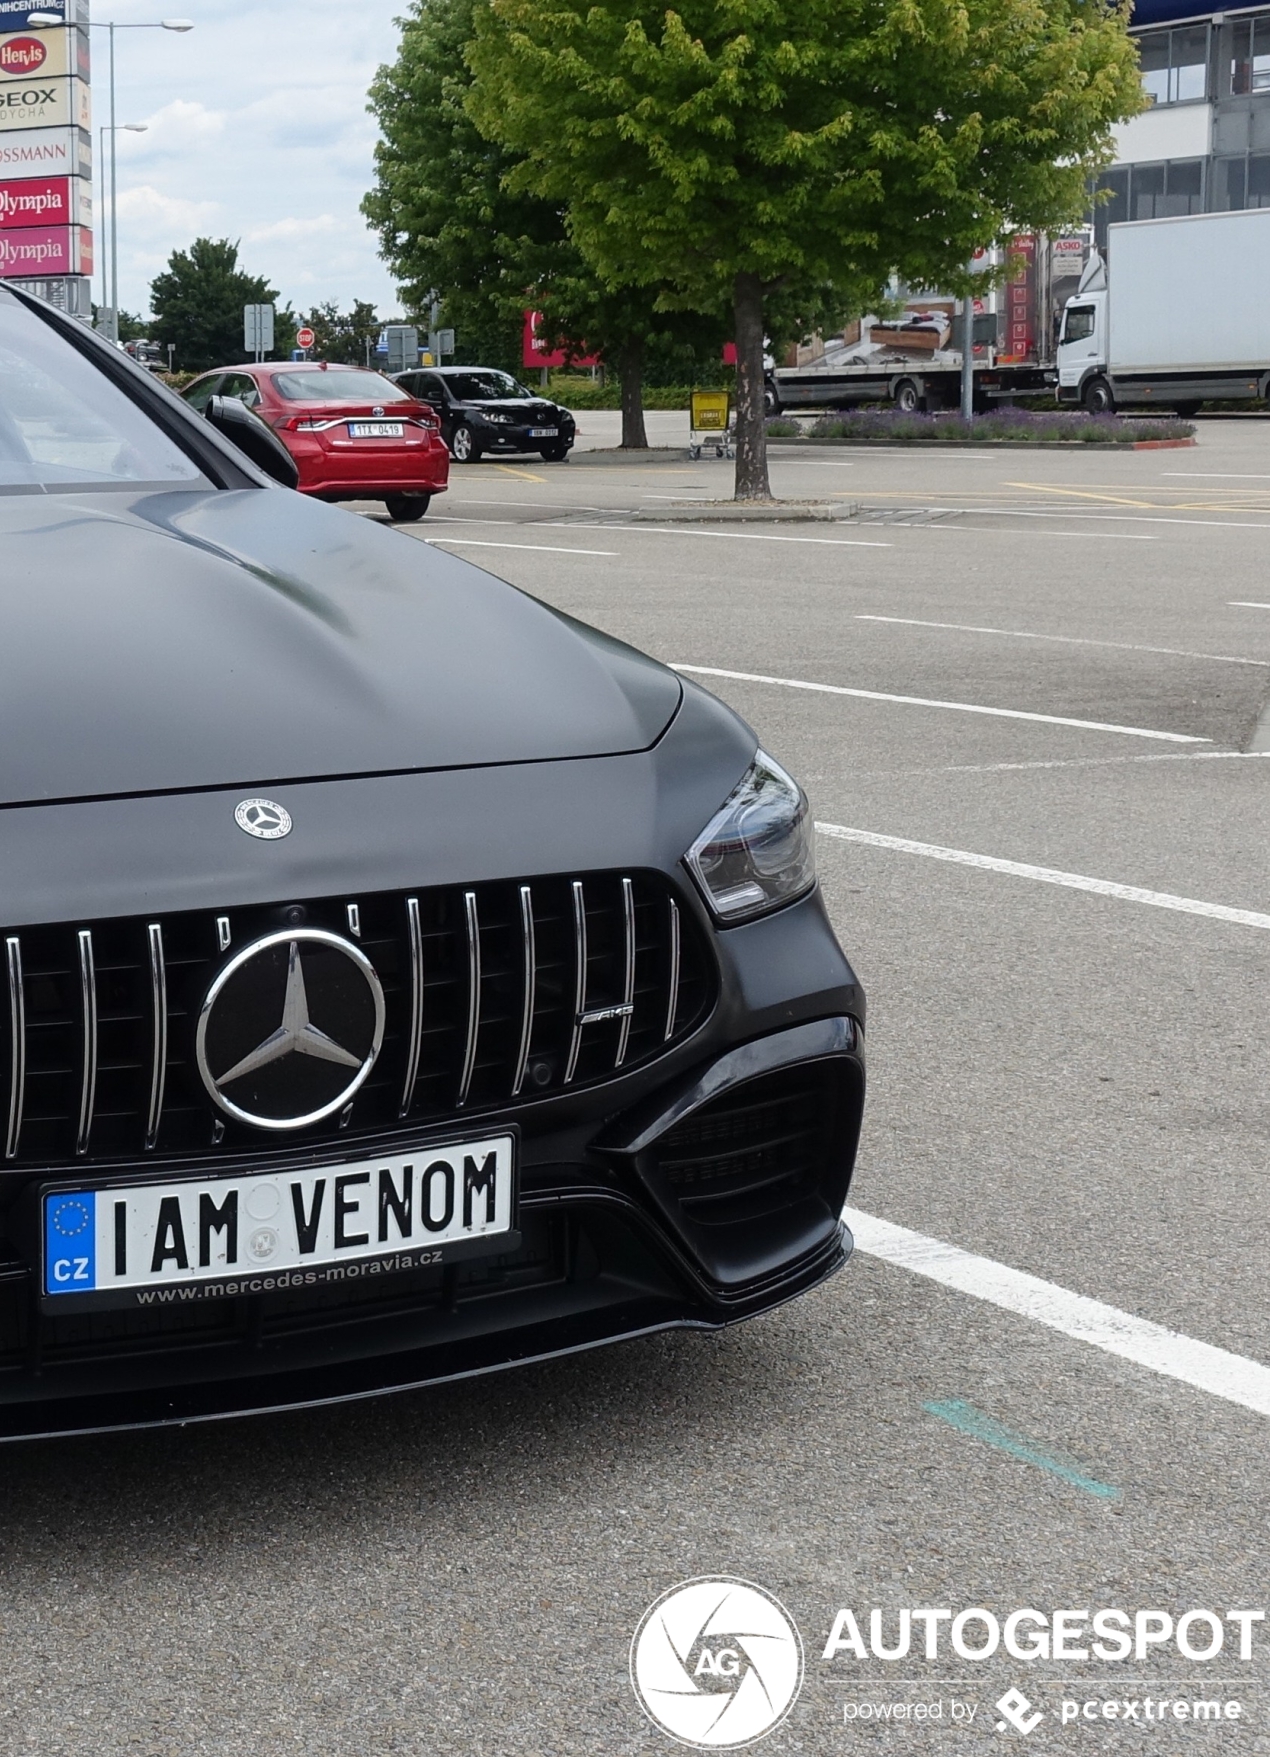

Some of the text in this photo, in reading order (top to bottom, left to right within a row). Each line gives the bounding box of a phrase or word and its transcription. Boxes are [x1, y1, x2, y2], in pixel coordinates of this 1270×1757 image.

[1, 46, 43, 65] Hervis
[1055, 242, 1080, 250] ASKO
[299, 334, 312, 342] STOP
[357, 424, 399, 434] 1TX 0419
[114, 1151, 497, 1276] I AM VENOM
[54, 1257, 89, 1281] CZ
[136, 1249, 443, 1305] www.mercedes-moravia.cz
